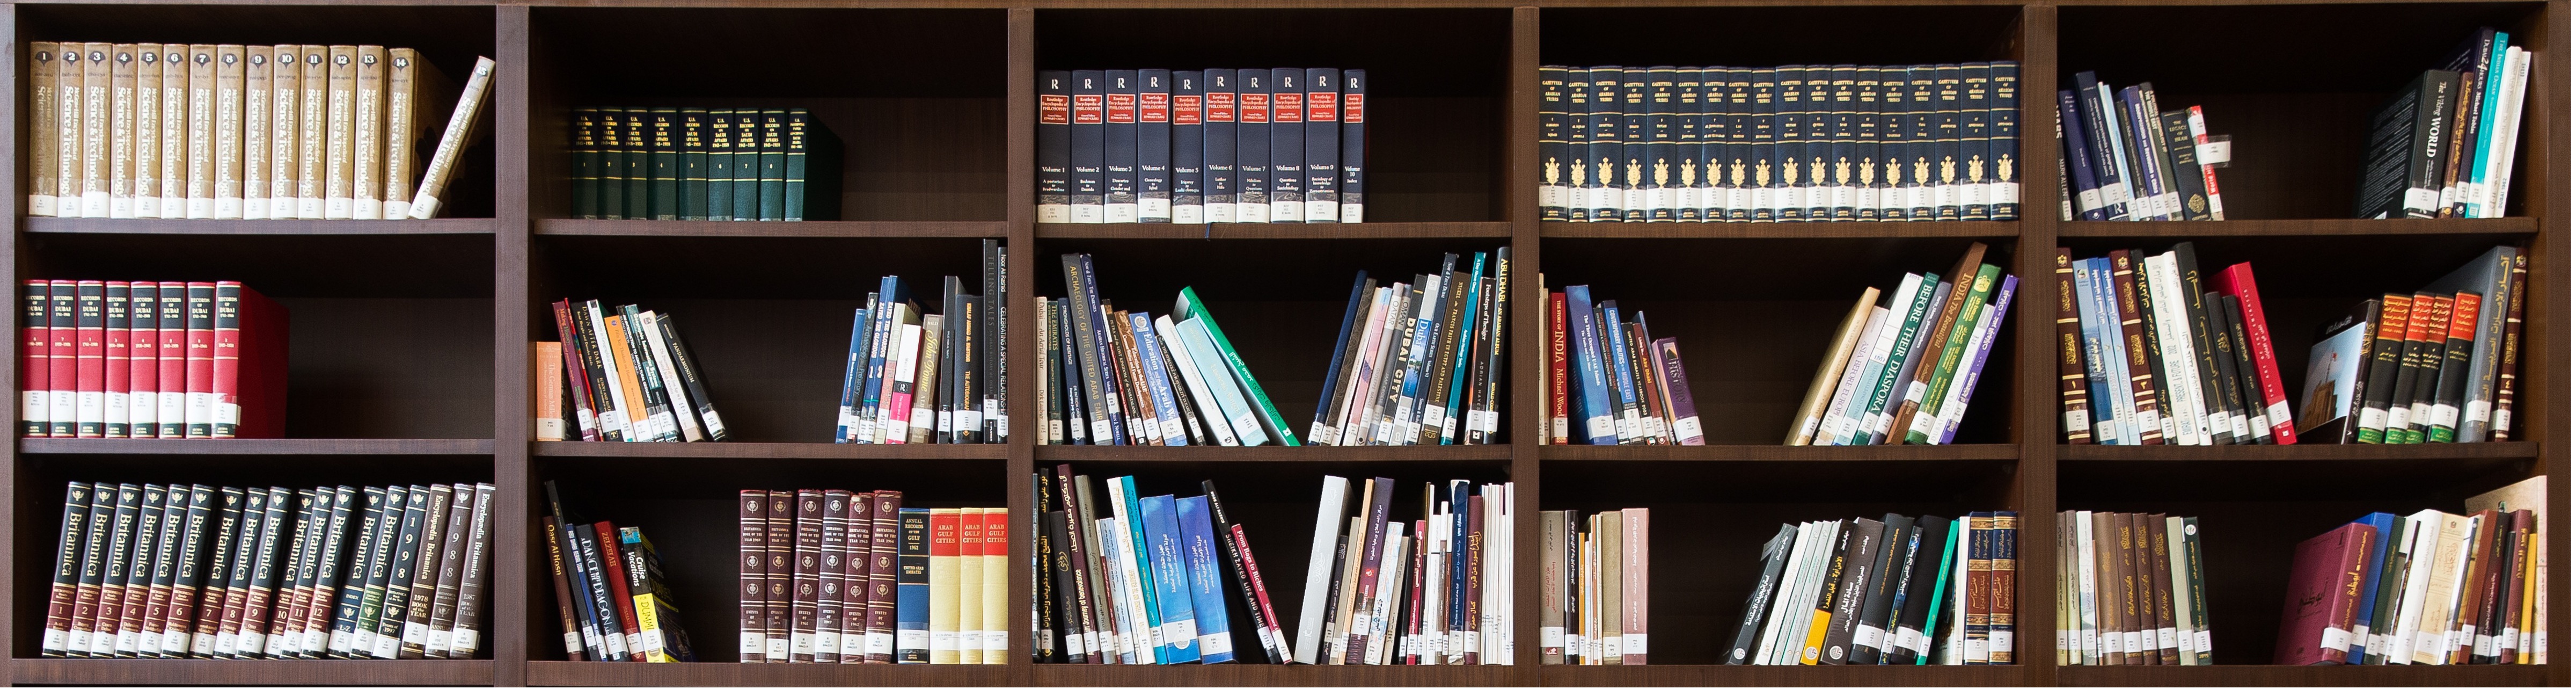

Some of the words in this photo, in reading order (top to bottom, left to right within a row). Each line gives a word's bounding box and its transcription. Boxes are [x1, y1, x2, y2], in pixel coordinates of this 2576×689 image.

[281, 54, 292, 63] 10
[363, 54, 375, 63] 13
[476, 65, 487, 76] 15
[2477, 58, 2489, 71] 24
[1051, 79, 1058, 89] R
[2438, 82, 2447, 93] The
[64, 86, 74, 129] Science
[2473, 92, 2481, 114] Michael
[2426, 118, 2442, 158] WORLD
[61, 136, 71, 196] Technology
[1070, 266, 1086, 320] ARCHAEOLOGY
[1909, 284, 1933, 323] BEFORE
[1953, 273, 1974, 302] INDIA
[1389, 301, 1399, 325] QATAR
[1398, 302, 1408, 325] OMAN
[1948, 301, 1958, 313] The
[2244, 289, 2256, 327] EMIRATES
[582, 307, 590, 327] DAWN
[588, 329, 596, 352] AFTER
[594, 351, 602, 369] DARK
[1080, 323, 1087, 331] OF
[1082, 334, 1091, 348] THE
[1399, 318, 1416, 362] DUBAI
[1415, 321, 1429, 347] Dubai
[1609, 310, 1620, 344] CONTEMPORARY
[1616, 344, 1624, 365] POLITICS
[1894, 327, 1915, 357] THEIR
[1934, 314, 1952, 349] Beautiful
[925, 330, 938, 359] John
[1555, 331, 1564, 362] INDIA
[1857, 341, 1869, 359] ASIA
[672, 343, 694, 383] PANDAEMONIUM
[869, 366, 873, 378] 1
[1085, 350, 1095, 378] UNITED
[1144, 333, 1158, 374] Education
[1159, 385, 1172, 408] Arab
[1848, 359, 1862, 385] BEFORE
[1090, 380, 1099, 399] ARAB
[1389, 369, 1403, 403] CITY
[1871, 360, 1900, 413] DIASPORA
[1094, 401, 1102, 420] EMIR
[182, 516, 204, 578] Britannica
[236, 518, 258, 581] Britannica
[286, 519, 309, 582] Britannica
[303, 517, 326, 579] Britannica
[323, 516, 345, 578] Britannica
[353, 517, 376, 579] Britannica
[374, 516, 397, 578] Britannica
[1237, 530, 1246, 548] From
[1243, 547, 1252, 563] Rags
[1249, 563, 1255, 572] to
[1253, 571, 1263, 592] Riches
[628, 552, 640, 587] Vacations
[636, 557, 645, 579] Cruise
[1225, 534, 1238, 558] SHEIKH
[1234, 557, 1246, 579] ZAYED
[1243, 582, 1252, 596] LIFE
[1249, 598, 1258, 611] AND
